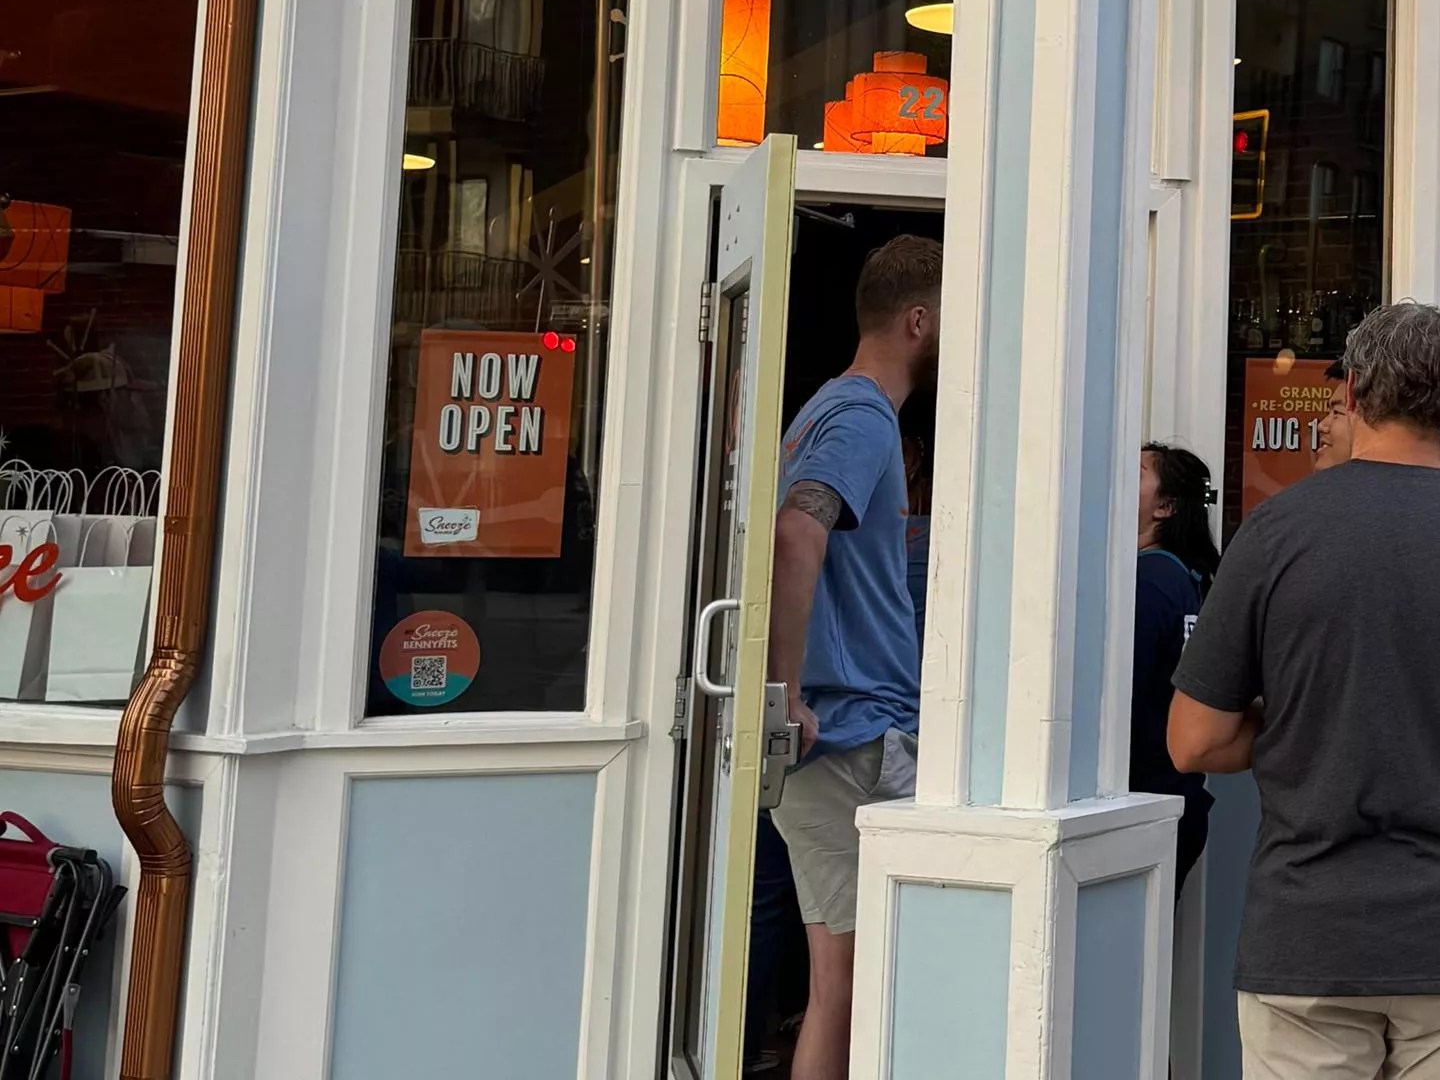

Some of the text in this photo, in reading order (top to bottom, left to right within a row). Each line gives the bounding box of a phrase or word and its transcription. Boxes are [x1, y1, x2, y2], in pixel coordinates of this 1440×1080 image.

[899, 85, 944, 121] 22
[450, 352, 542, 402] NOW
[1280, 386, 1333, 399] GRAND
[439, 404, 545, 456] OPEN
[1252, 417, 1300, 451] AUG
